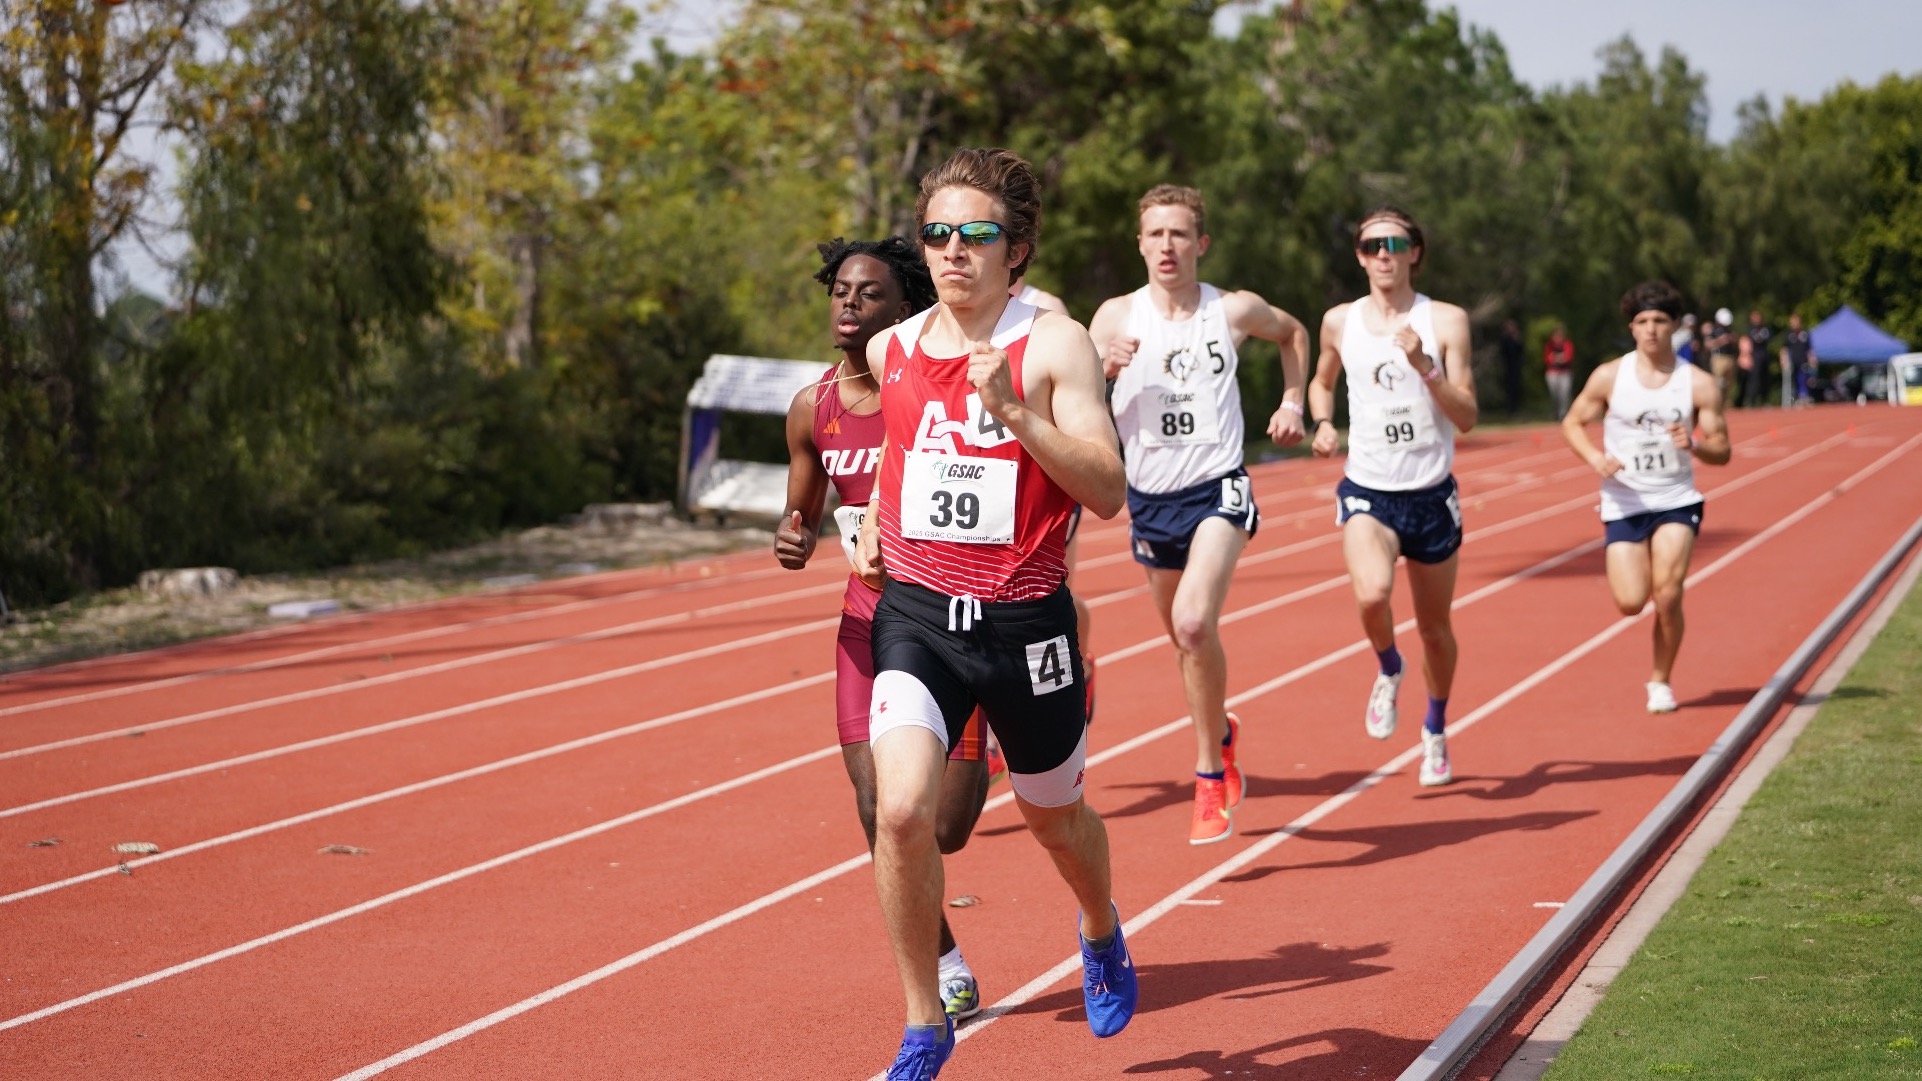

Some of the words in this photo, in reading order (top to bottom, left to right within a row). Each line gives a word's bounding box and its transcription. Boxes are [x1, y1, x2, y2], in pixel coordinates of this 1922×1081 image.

[1207, 340, 1225, 374] 5
[977, 402, 1005, 440] 4
[1161, 411, 1195, 436] 89
[1386, 421, 1414, 443] 99
[948, 463, 985, 480] GSAC
[1634, 453, 1665, 470] 121
[1231, 477, 1243, 507] 5
[930, 490, 980, 530] 39
[924, 531, 945, 539] GSAC
[946, 533, 1001, 542] Championships
[1038, 641, 1066, 686] 4
